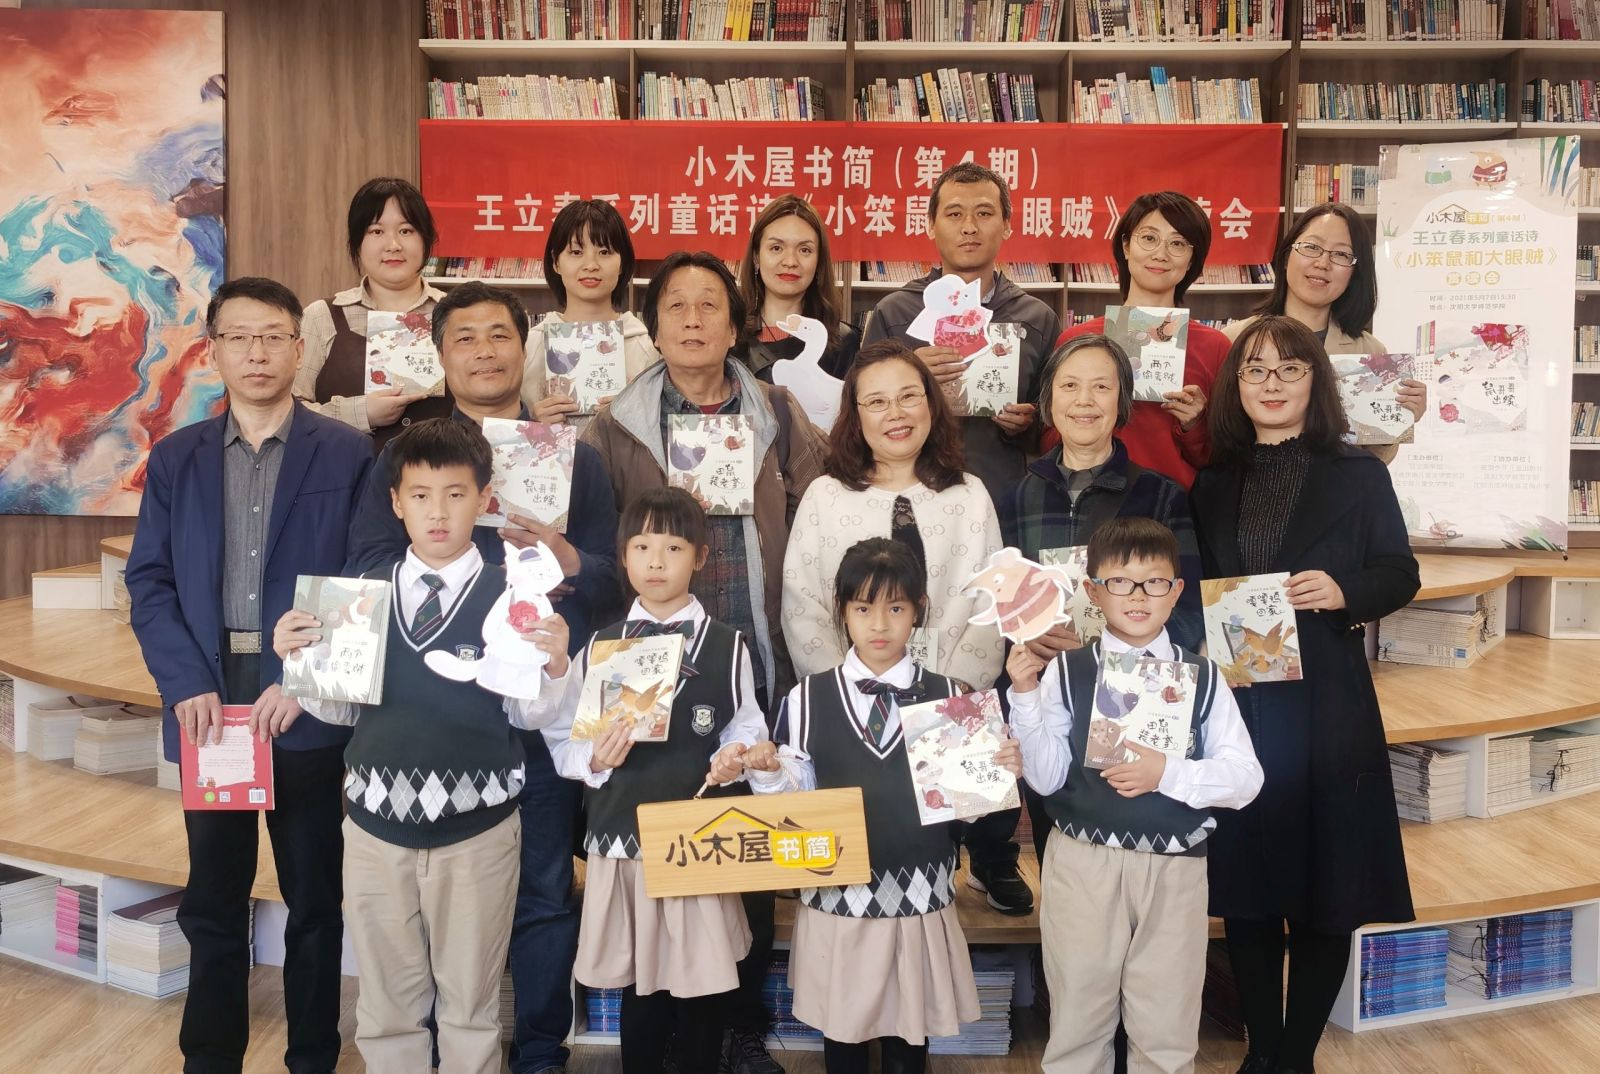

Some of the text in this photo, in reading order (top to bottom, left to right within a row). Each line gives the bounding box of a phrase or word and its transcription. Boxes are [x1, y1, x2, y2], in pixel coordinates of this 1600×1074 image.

[1412, 230, 1538, 246] 王立春系列童话诗
[1393, 247, 1557, 269] 《小笨鼠和大眼贼》
[665, 831, 831, 867] 小木屋书简
